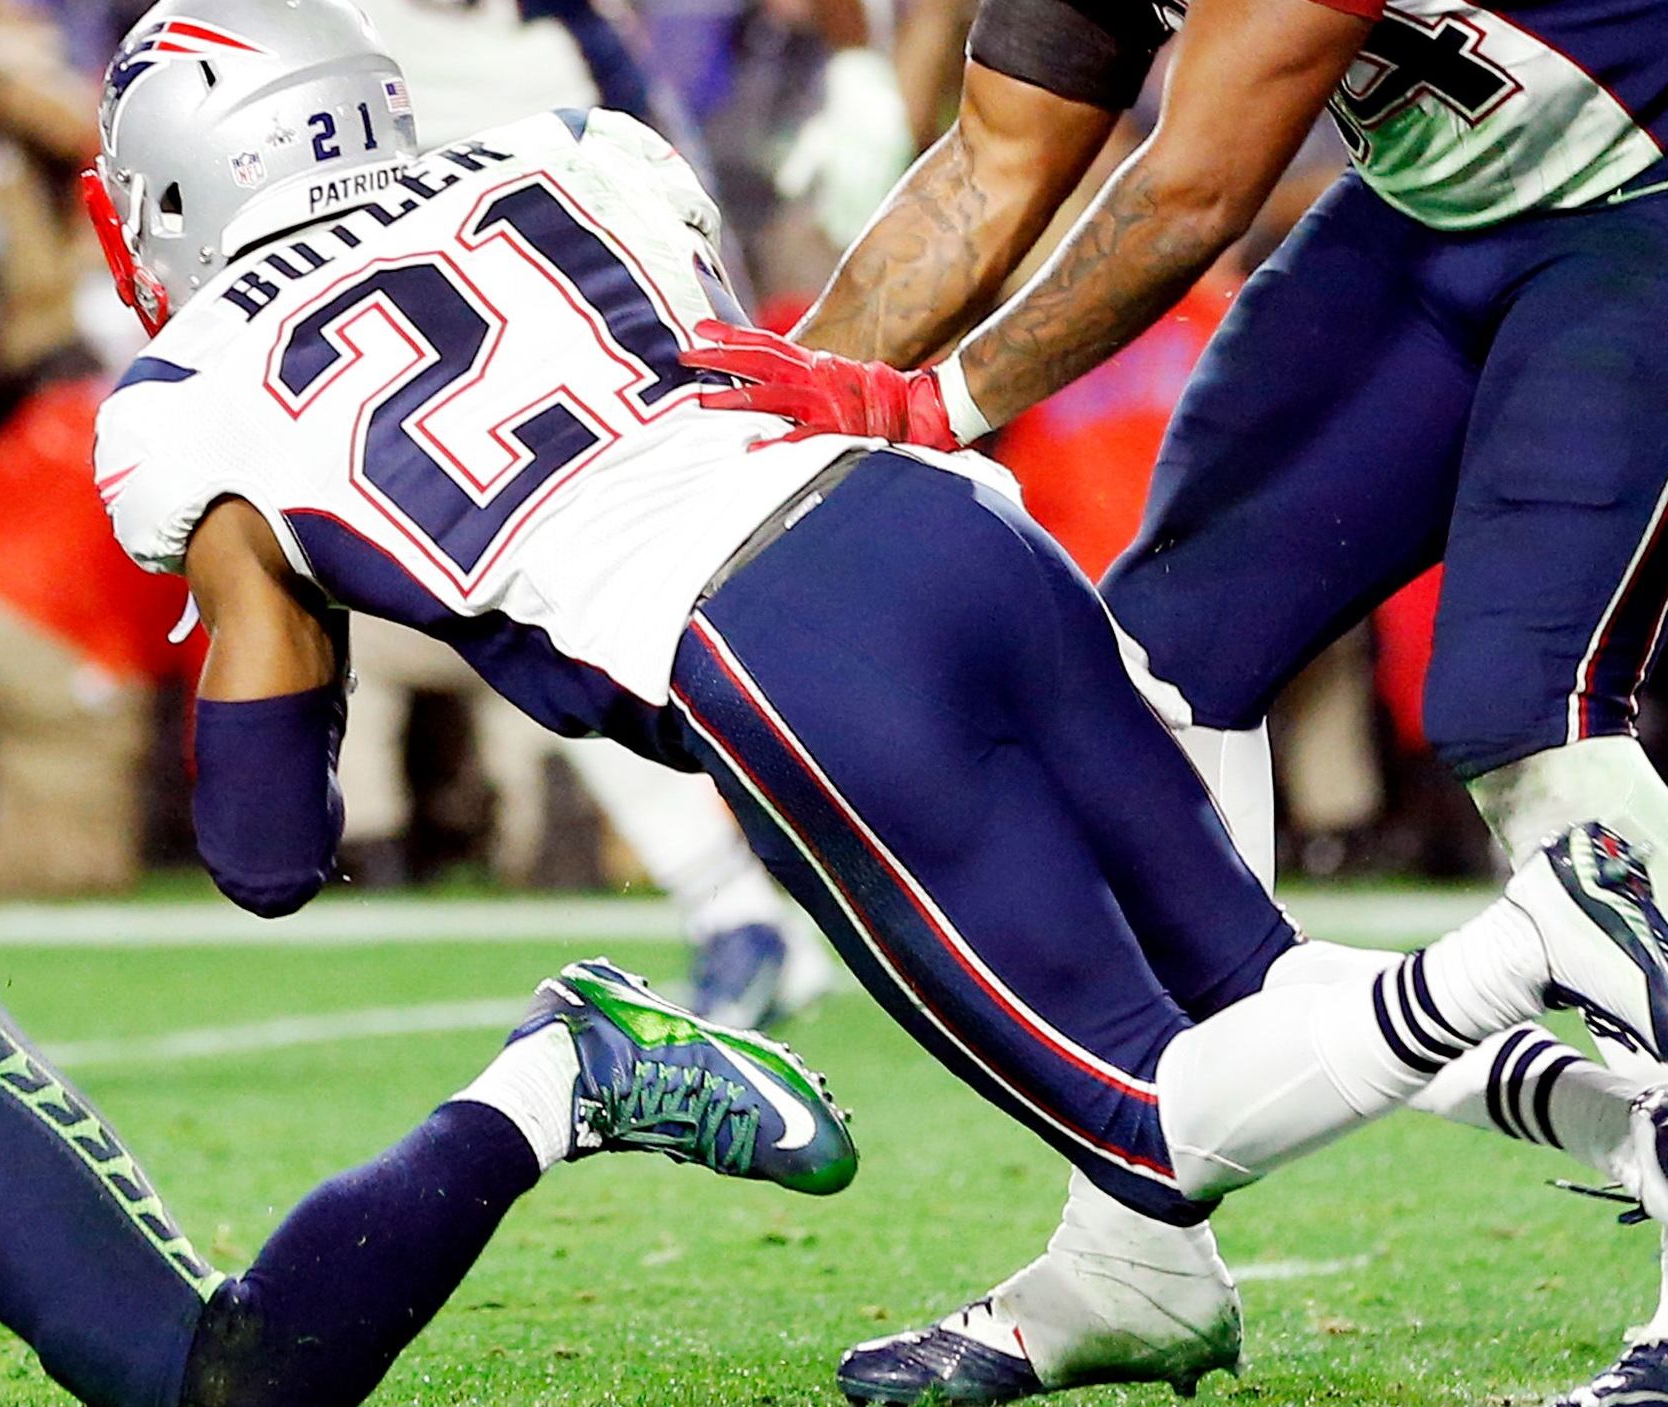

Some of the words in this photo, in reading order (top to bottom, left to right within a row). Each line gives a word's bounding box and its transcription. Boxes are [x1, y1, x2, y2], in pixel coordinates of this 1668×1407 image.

[308, 103, 377, 161] 21
[308, 165, 409, 213] PATRIOT
[221, 141, 514, 322] BUTLER
[262, 170, 734, 598] 21
